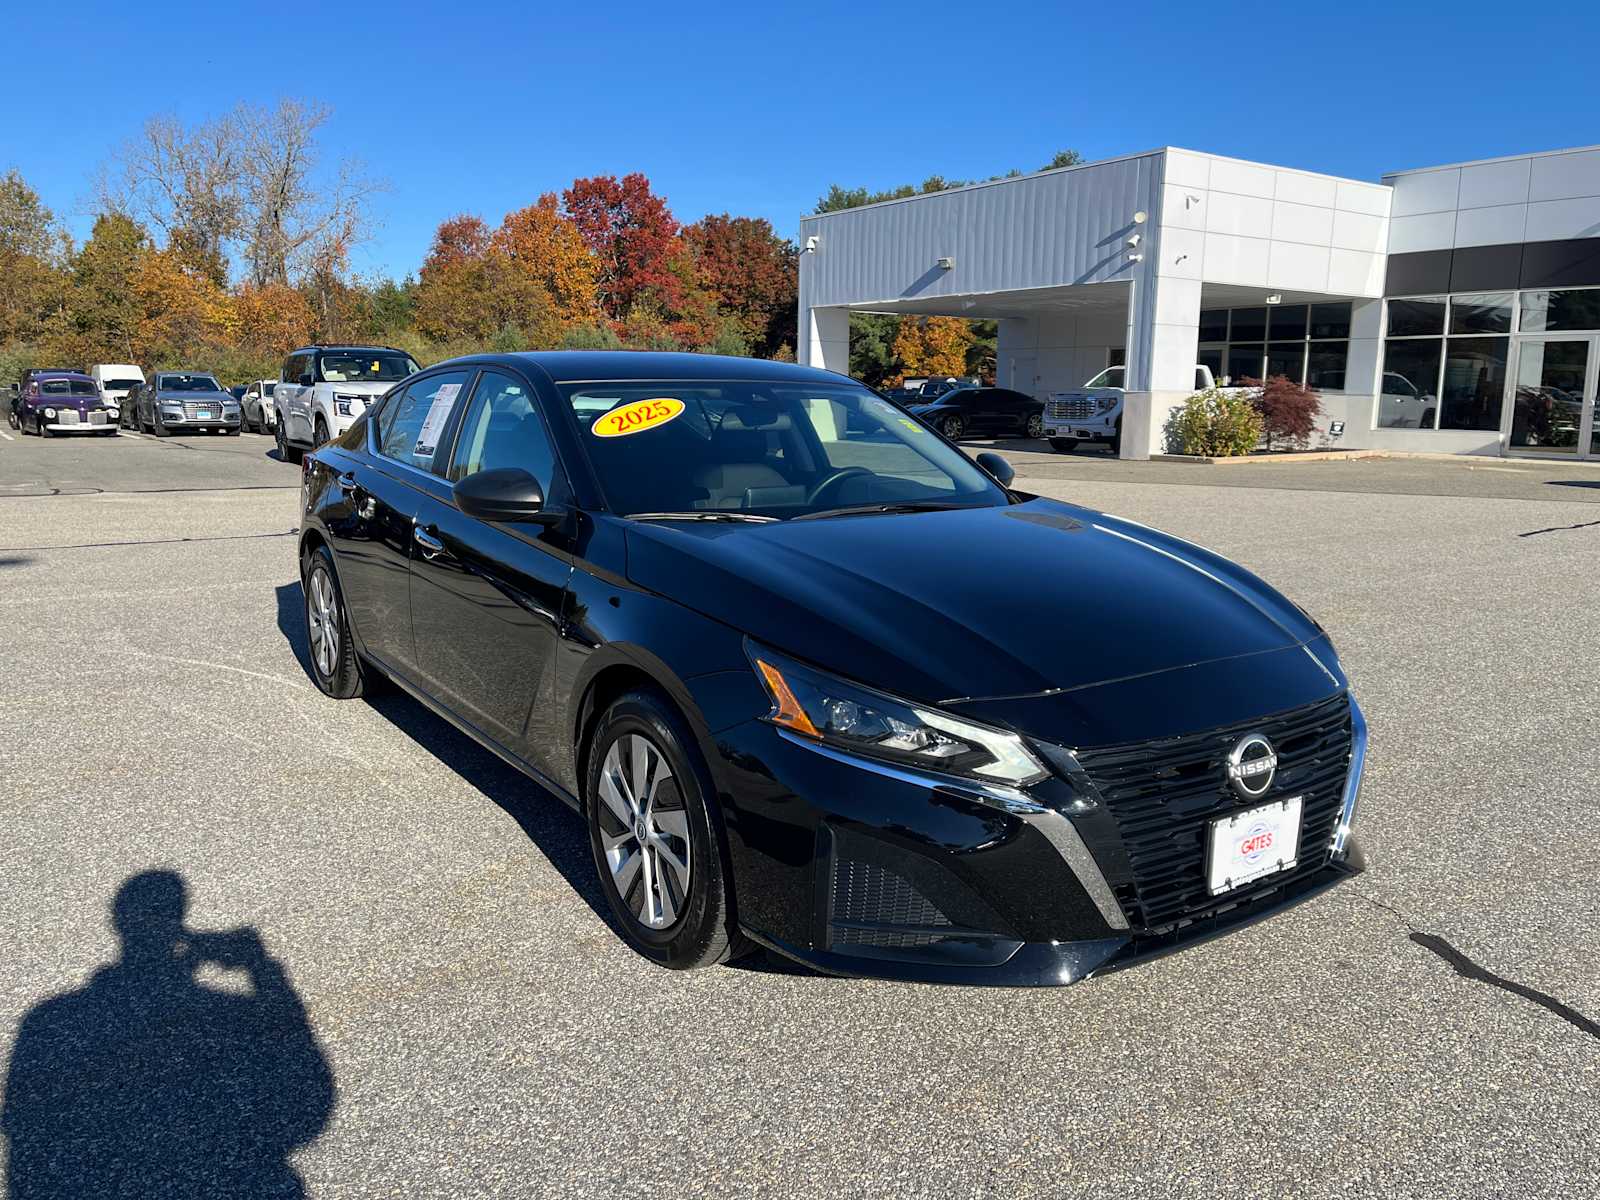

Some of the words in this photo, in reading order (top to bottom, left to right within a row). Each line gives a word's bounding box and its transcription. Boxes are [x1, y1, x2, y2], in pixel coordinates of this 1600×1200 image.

[611, 402, 671, 432] 2025
[1231, 755, 1277, 777] NISSAN
[1241, 833, 1272, 854] GATES
